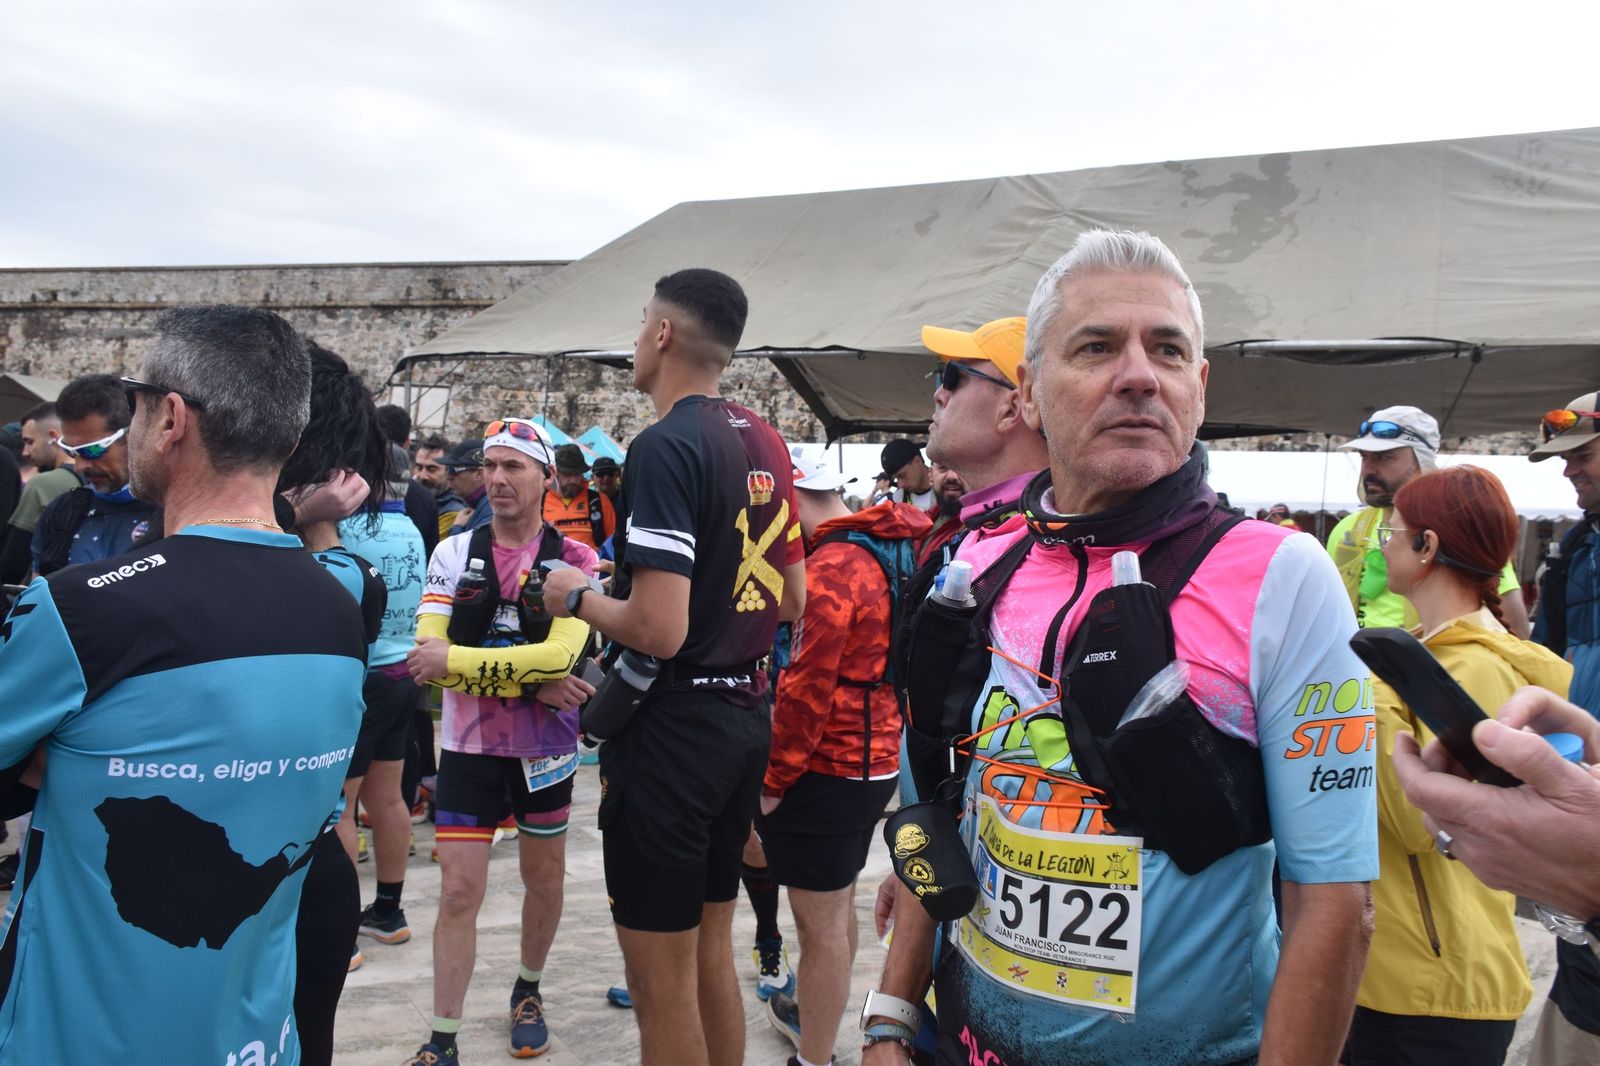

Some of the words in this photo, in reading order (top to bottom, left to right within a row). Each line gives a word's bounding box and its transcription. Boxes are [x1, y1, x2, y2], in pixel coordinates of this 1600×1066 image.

[87, 560, 149, 588] emec
[1090, 651, 1117, 663] TERREX
[108, 757, 205, 783] Busca,
[213, 760, 273, 782] eliga
[278, 758, 291, 777] y
[295, 748, 347, 771] compra
[1309, 764, 1373, 793] team
[1000, 873, 1131, 951] 5122
[994, 924, 1013, 940] JUAN
[1014, 932, 1067, 954] FRANCISCO
